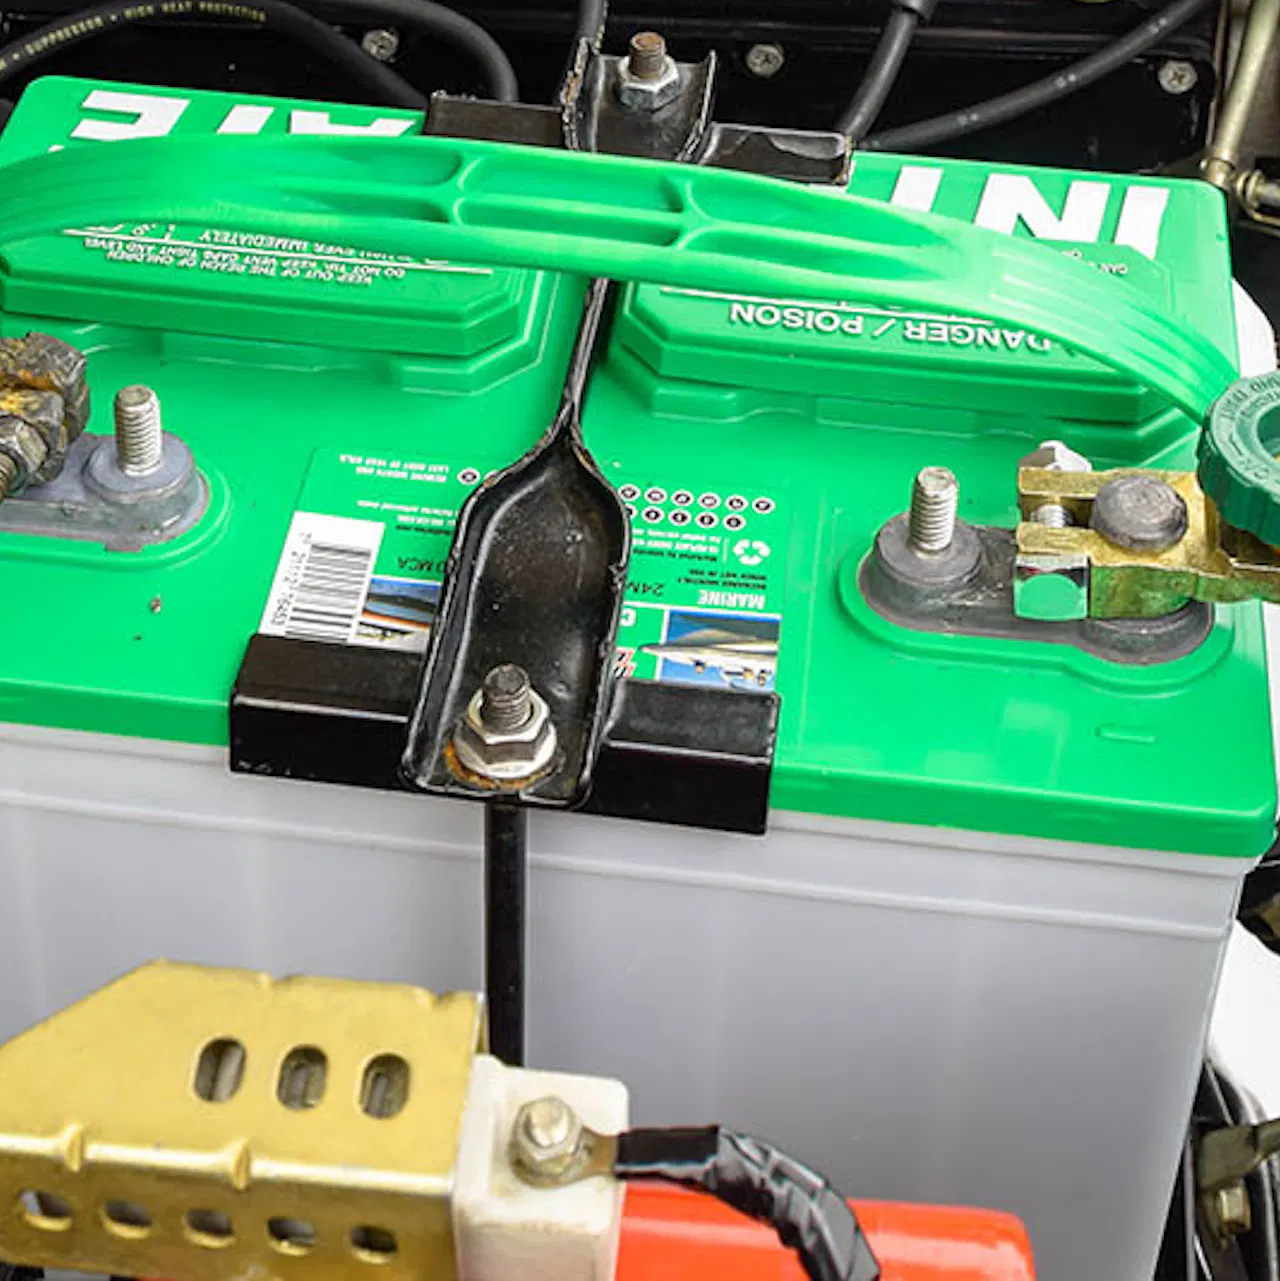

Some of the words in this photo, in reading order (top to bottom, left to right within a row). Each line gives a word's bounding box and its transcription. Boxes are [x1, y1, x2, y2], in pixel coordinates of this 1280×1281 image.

[199, 229, 308, 253] IMMEDIATELY
[105, 250, 173, 265] CHILDREN
[176, 257, 197, 268] OF
[199, 259, 246, 274] REACH
[248, 265, 276, 277] THE
[280, 268, 300, 278] OF
[384, 267, 406, 279] DO
[304, 269, 334, 282] OUT
[336, 273, 372, 286] KEEP
[730, 303, 864, 335] POISON
[397, 556, 433, 573] MCA
[696, 589, 766, 611] MARINE
